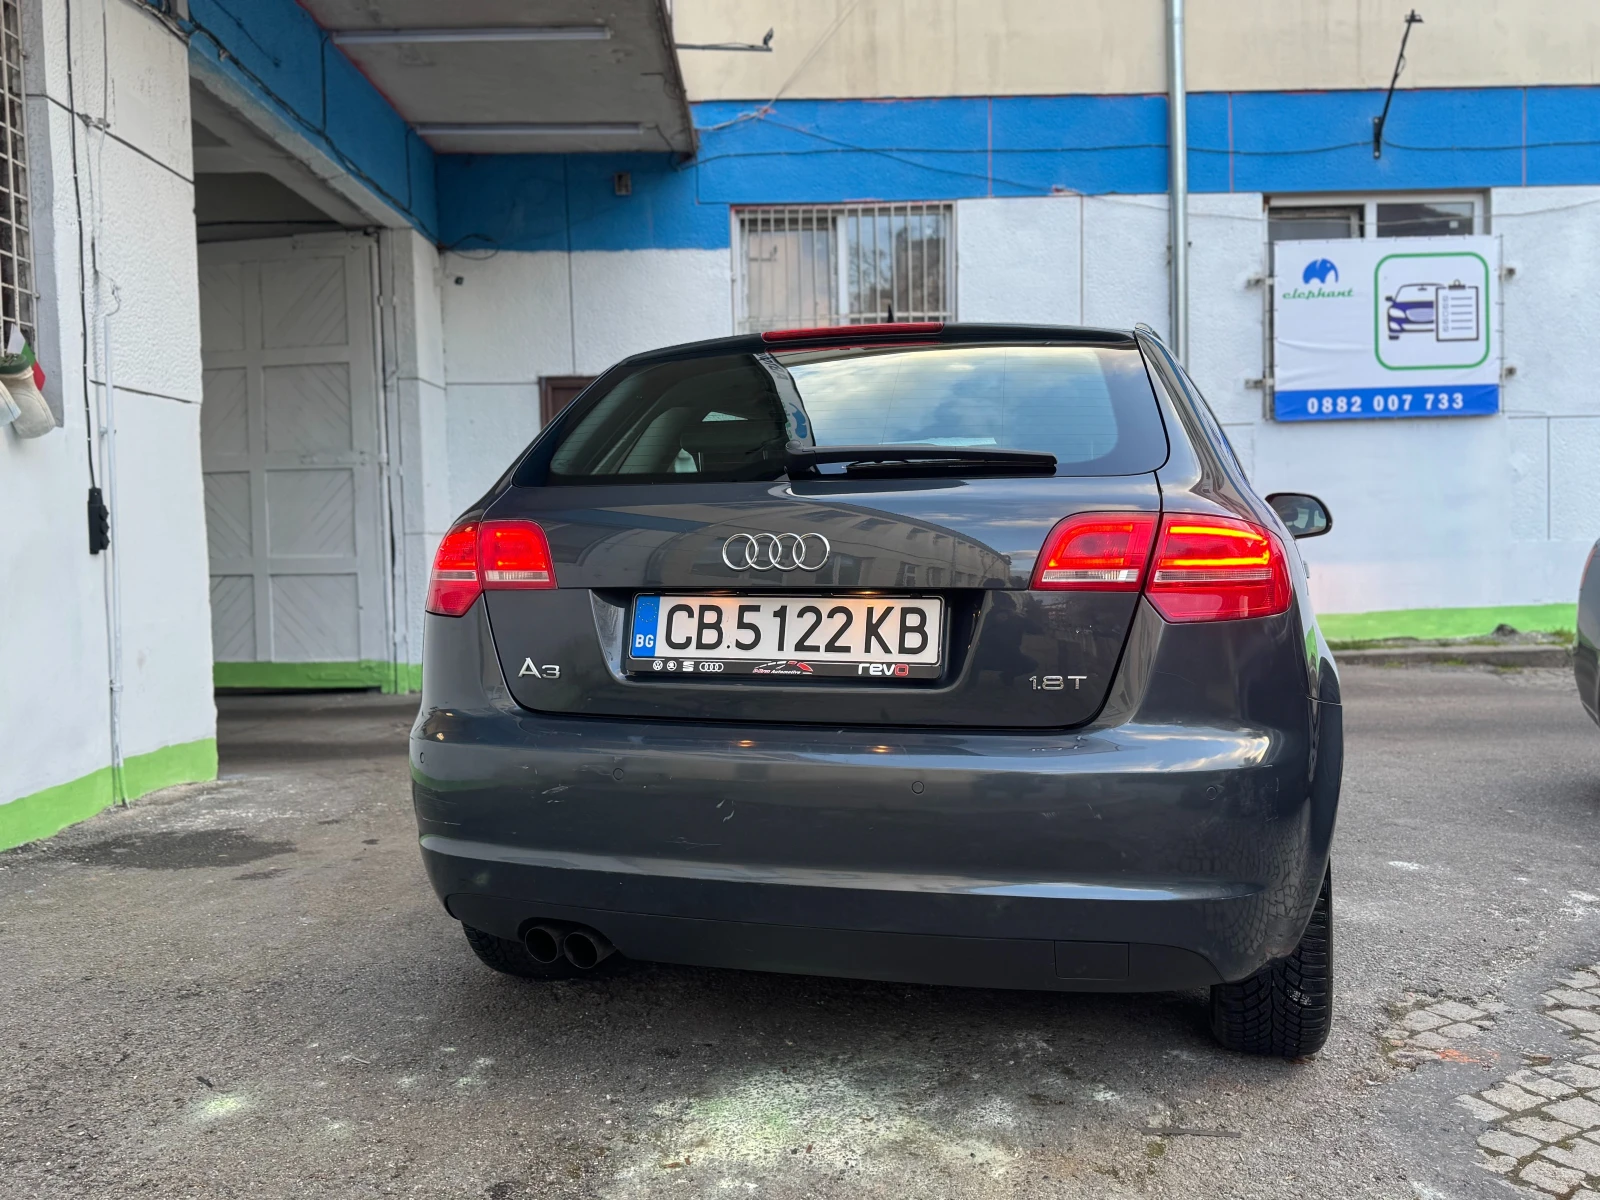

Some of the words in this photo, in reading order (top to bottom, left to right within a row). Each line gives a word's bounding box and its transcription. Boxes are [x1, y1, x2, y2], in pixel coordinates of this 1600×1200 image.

[1282, 287, 1354, 300] elephant
[1307, 396, 1362, 414] 0882
[1373, 394, 1413, 412] 007
[1424, 393, 1464, 411] 733
[635, 634, 654, 648] BG
[517, 657, 561, 679] A3
[858, 663, 909, 677] revo
